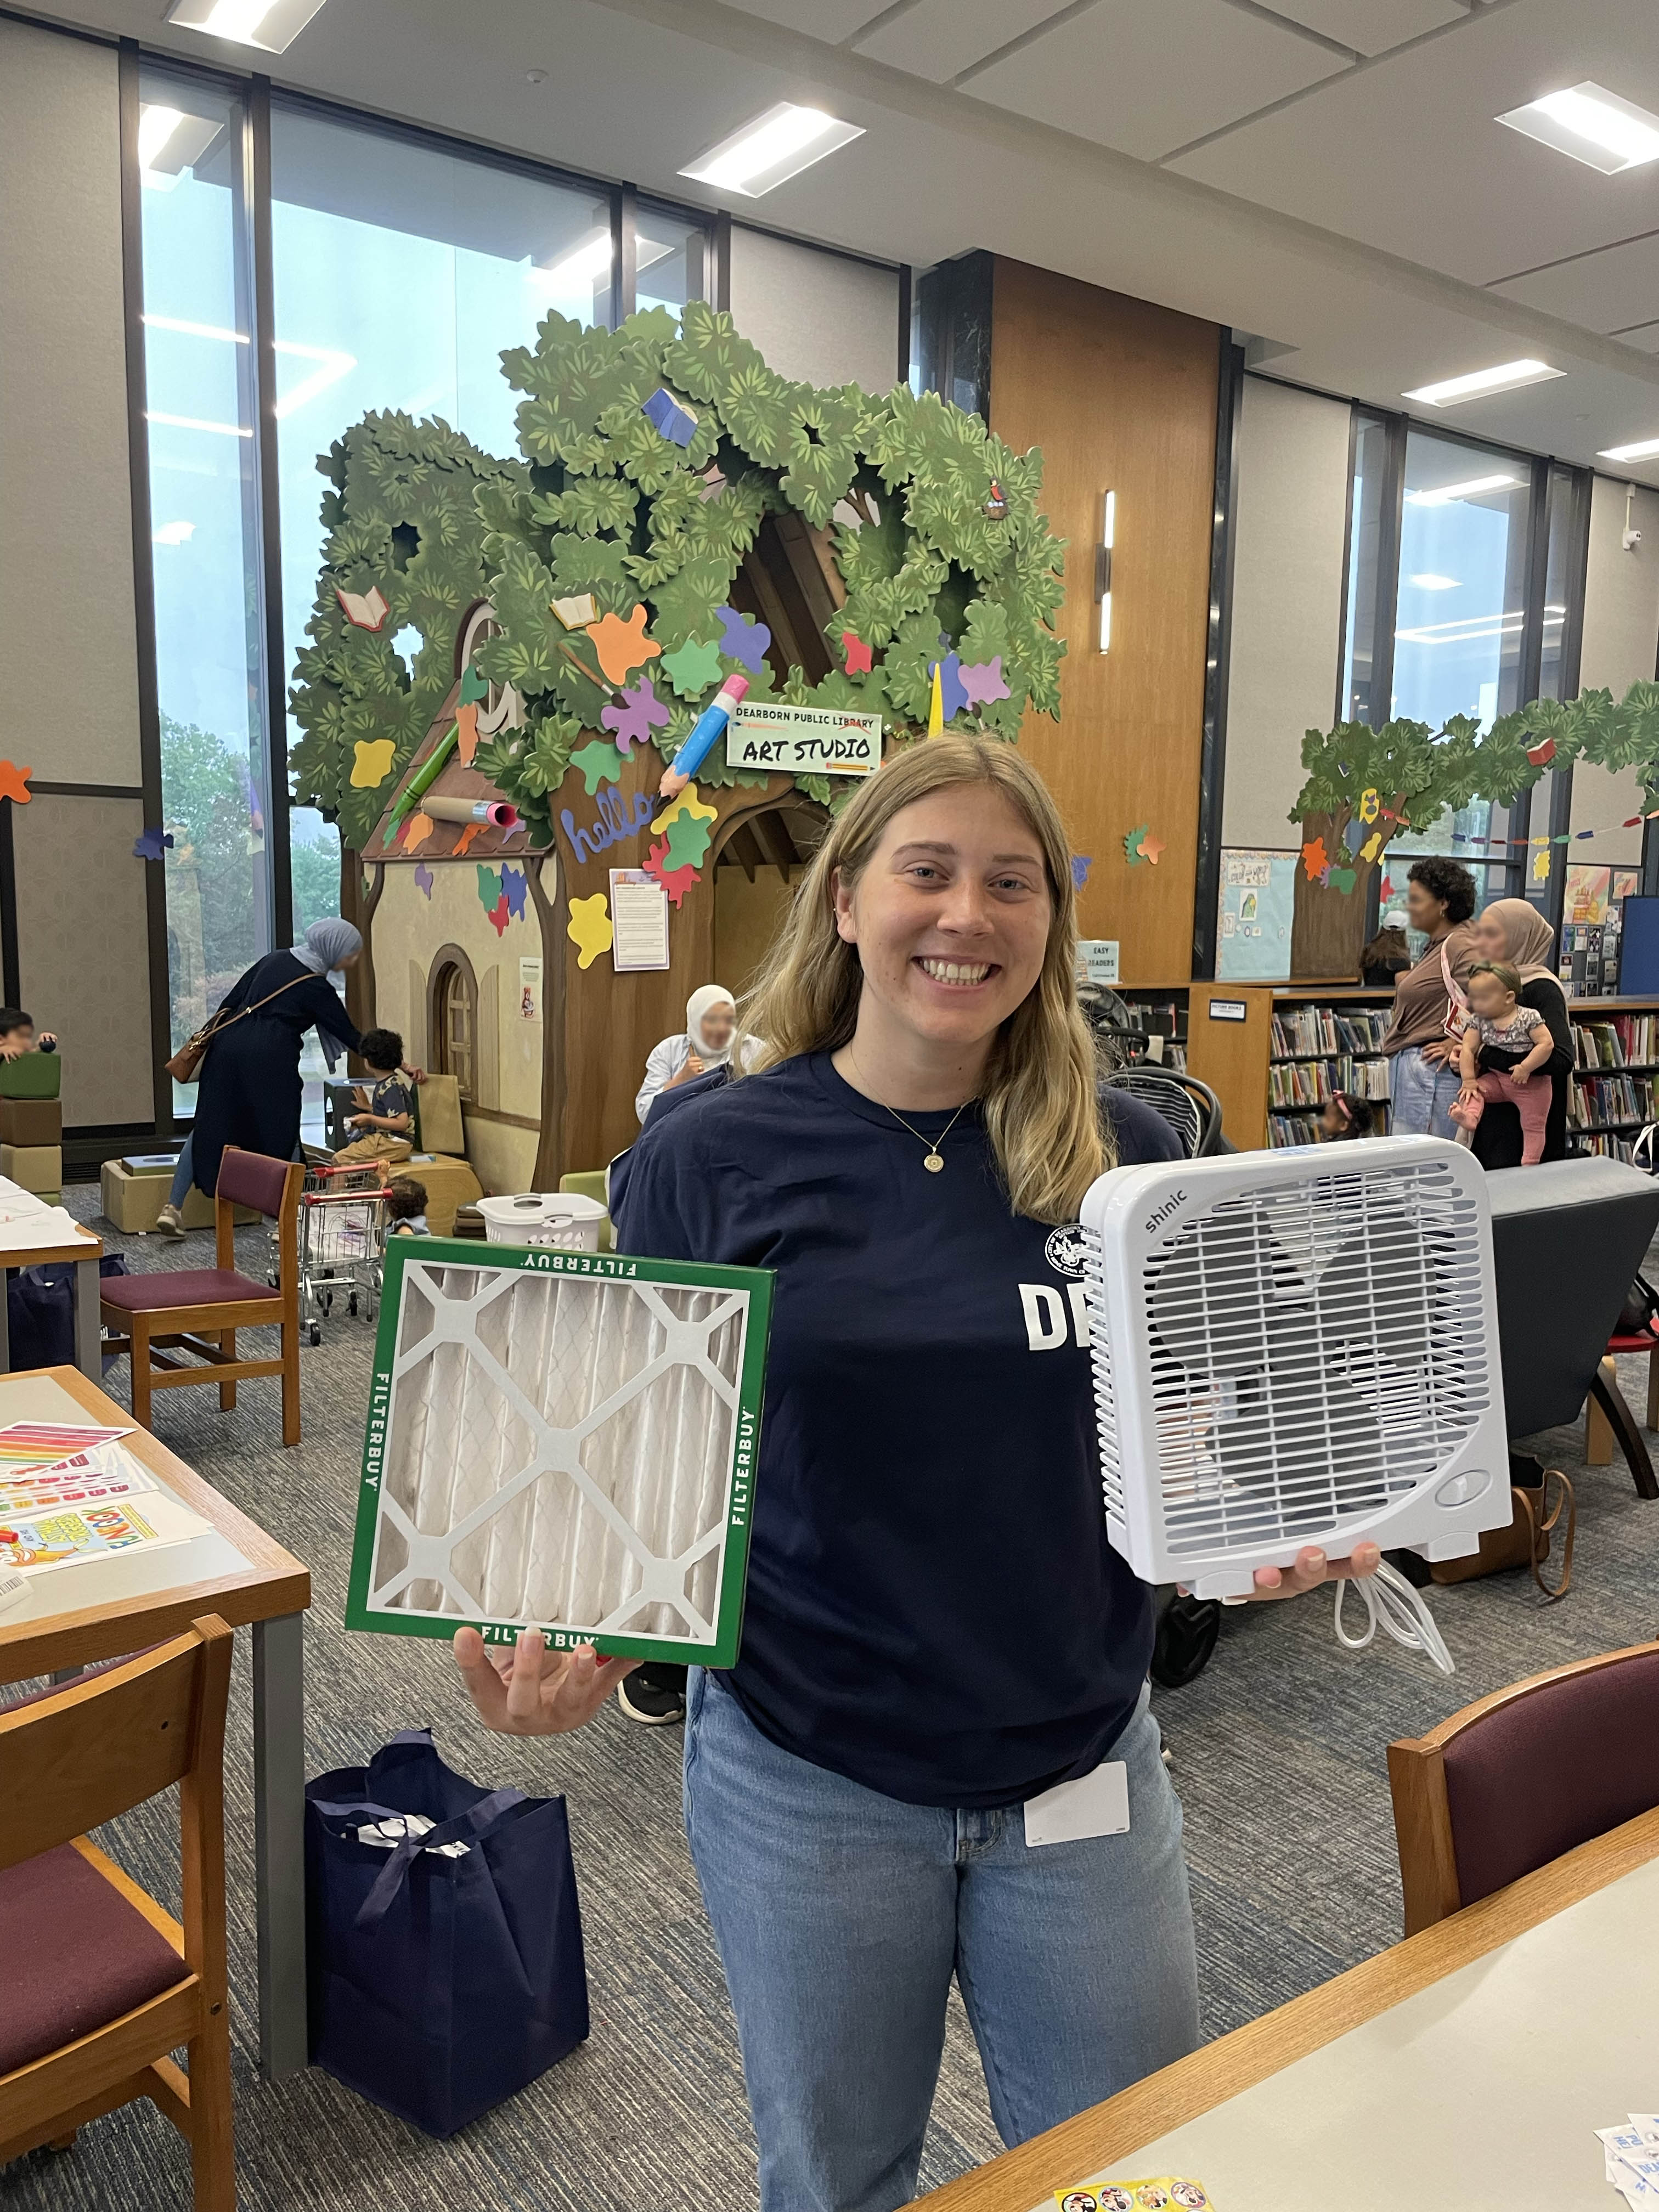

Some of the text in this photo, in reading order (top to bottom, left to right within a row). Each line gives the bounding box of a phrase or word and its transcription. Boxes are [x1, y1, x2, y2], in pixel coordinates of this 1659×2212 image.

[736, 707, 874, 729] DEARBORN PUBLIC LIBRARY
[743, 738, 870, 761] ART STUDIO
[560, 785, 656, 864] hello
[1146, 1190, 1187, 1233] shinic
[523, 1253, 637, 1277] FILTERBUY
[365, 1373, 390, 1488] FILTERBUY
[731, 1409, 755, 1526] FILTERBUY
